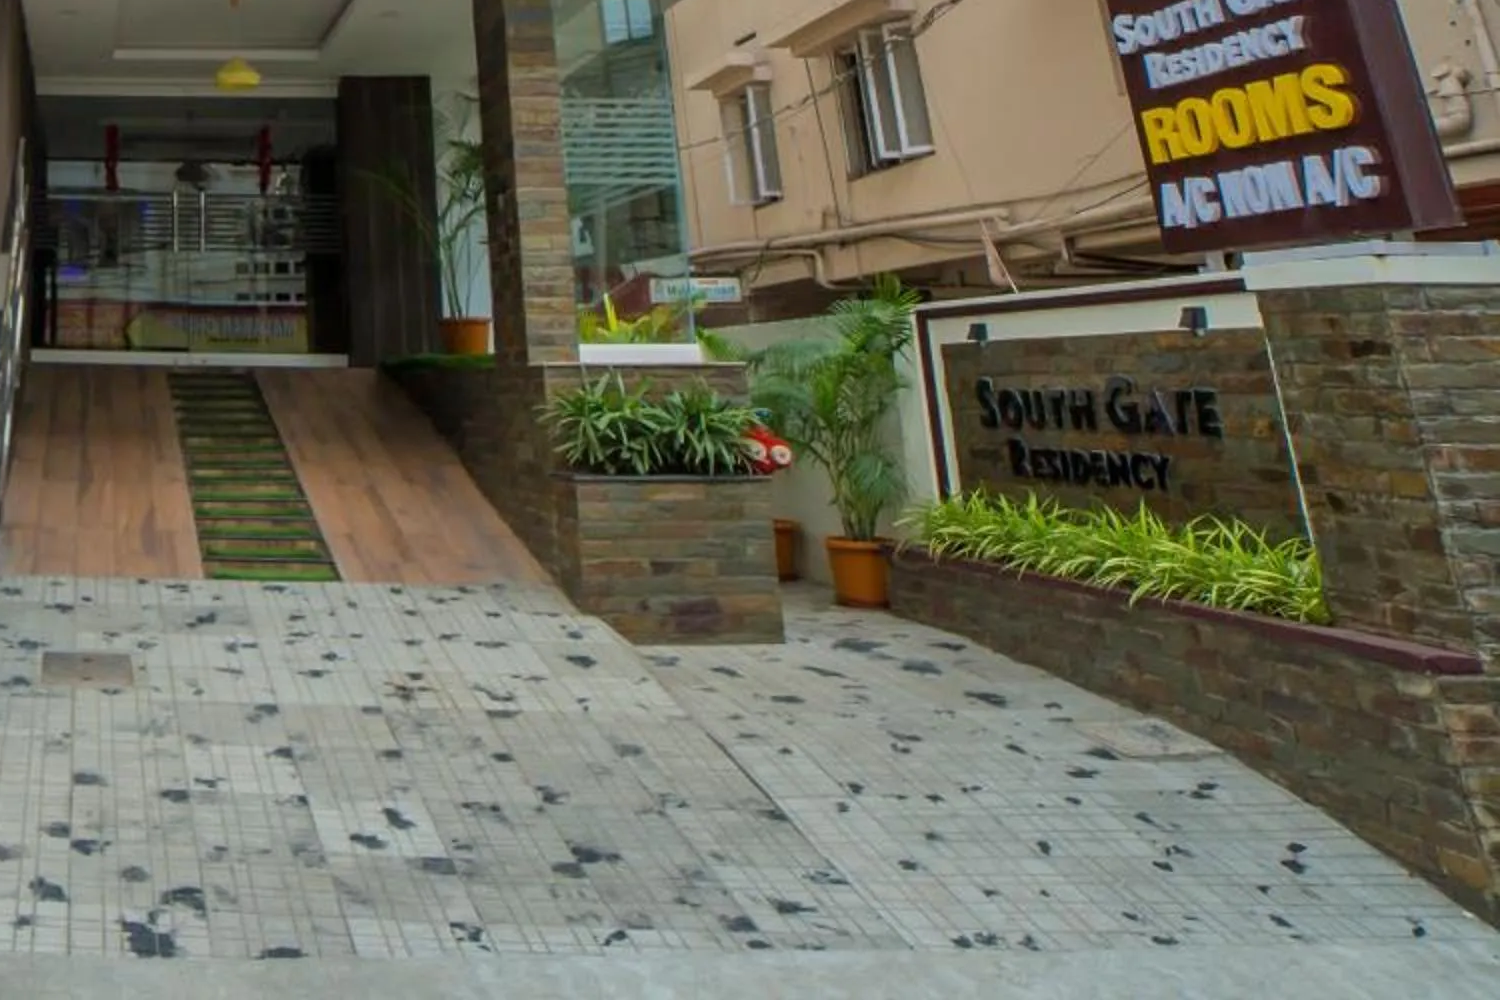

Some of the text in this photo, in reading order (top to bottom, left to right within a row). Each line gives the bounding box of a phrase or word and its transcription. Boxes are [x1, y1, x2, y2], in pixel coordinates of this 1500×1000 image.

[1143, 15, 1308, 90] RESIDENCY
[1141, 63, 1356, 166] ROOMS
[1160, 145, 1384, 230] A/C NON A/C
[975, 373, 1225, 440] SOUTH GATE
[1006, 435, 1172, 492] RESIDENCY
